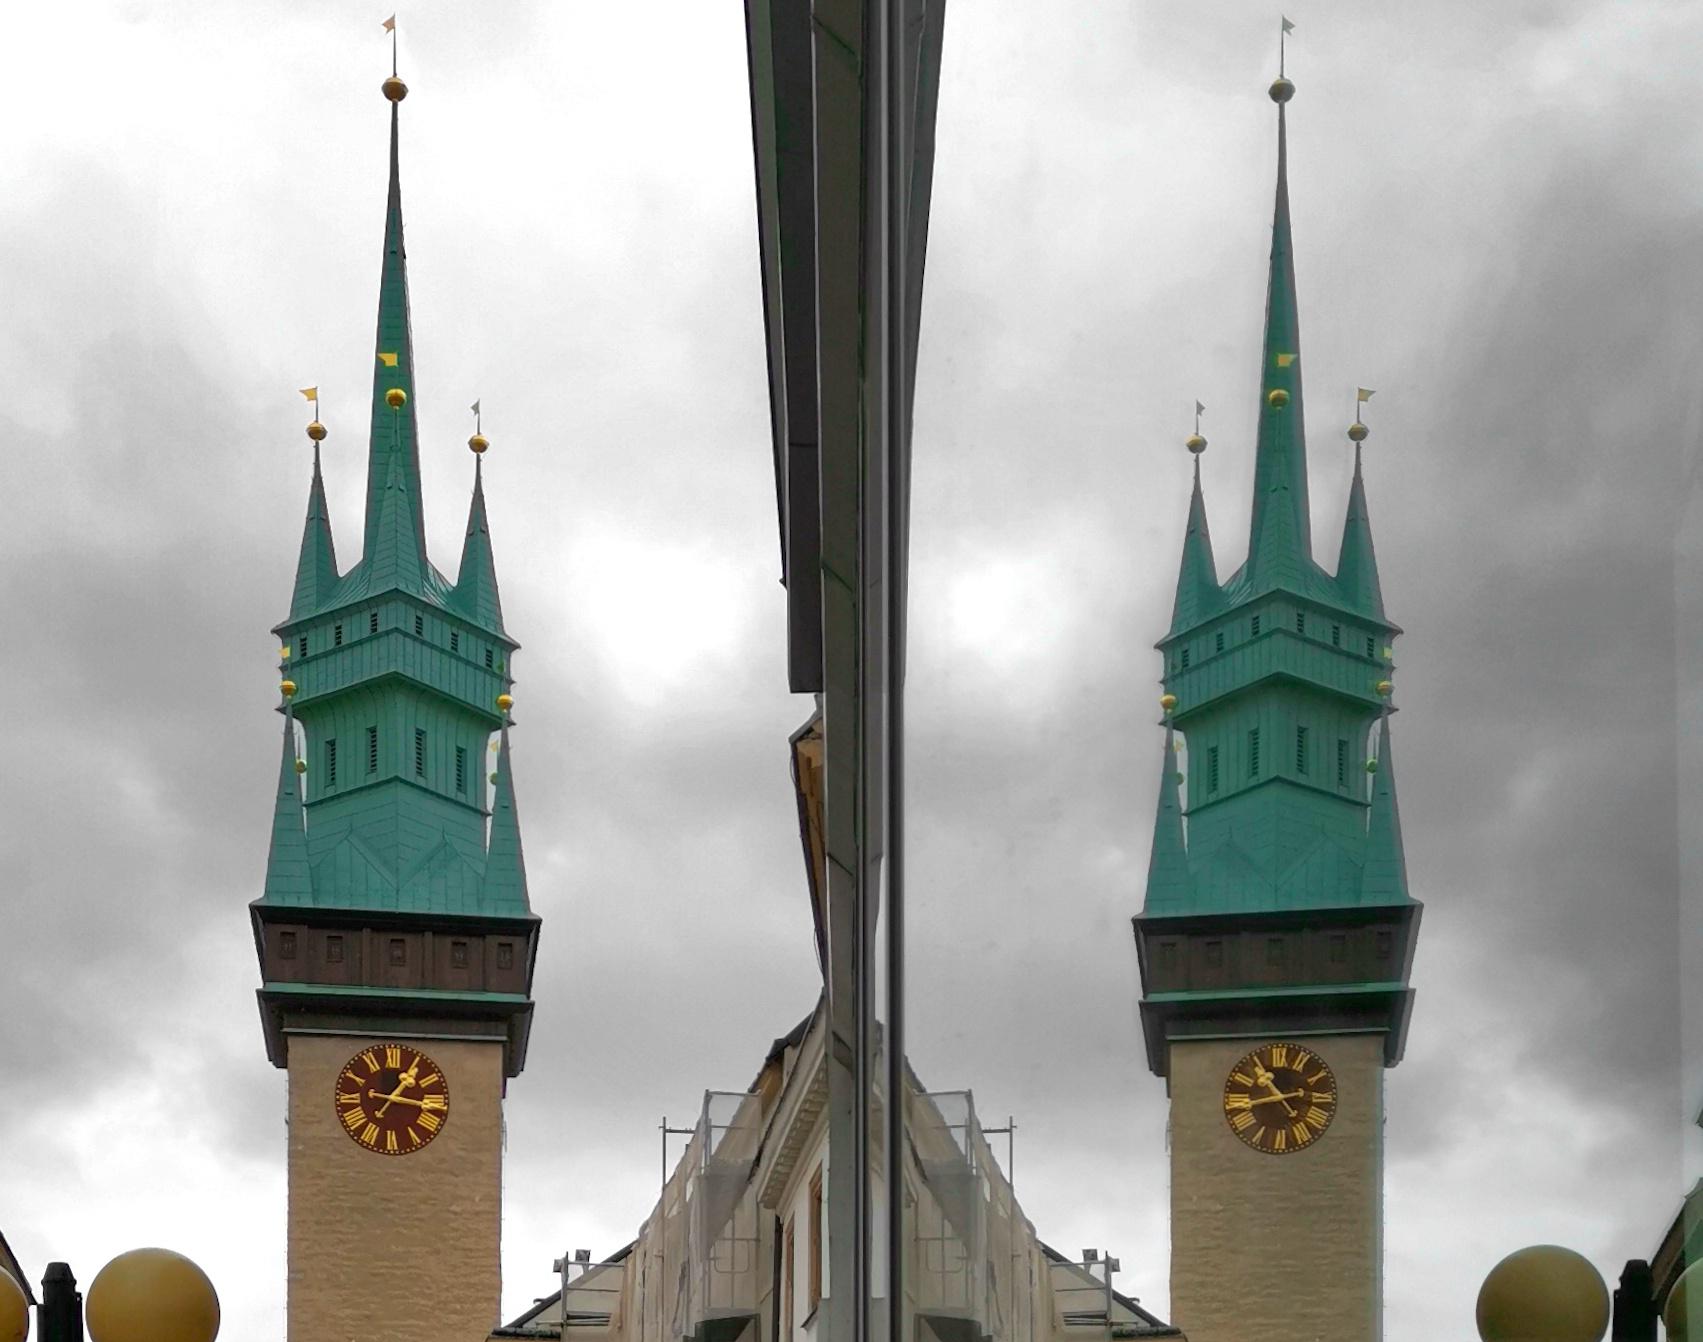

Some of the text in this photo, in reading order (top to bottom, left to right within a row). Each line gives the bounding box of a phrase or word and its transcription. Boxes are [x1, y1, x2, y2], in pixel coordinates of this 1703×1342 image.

[362, 1051, 380, 1073] XI
[385, 1048, 400, 1068] XII
[345, 1070, 366, 1087] X
[419, 1073, 439, 1088] II
[340, 1092, 360, 1103] IX
[343, 1106, 368, 1130] VIII
[416, 1111, 440, 1132] IIII
[361, 1122, 380, 1146] VII
[386, 1130, 398, 1150] VI
[407, 1126, 421, 1146] V
